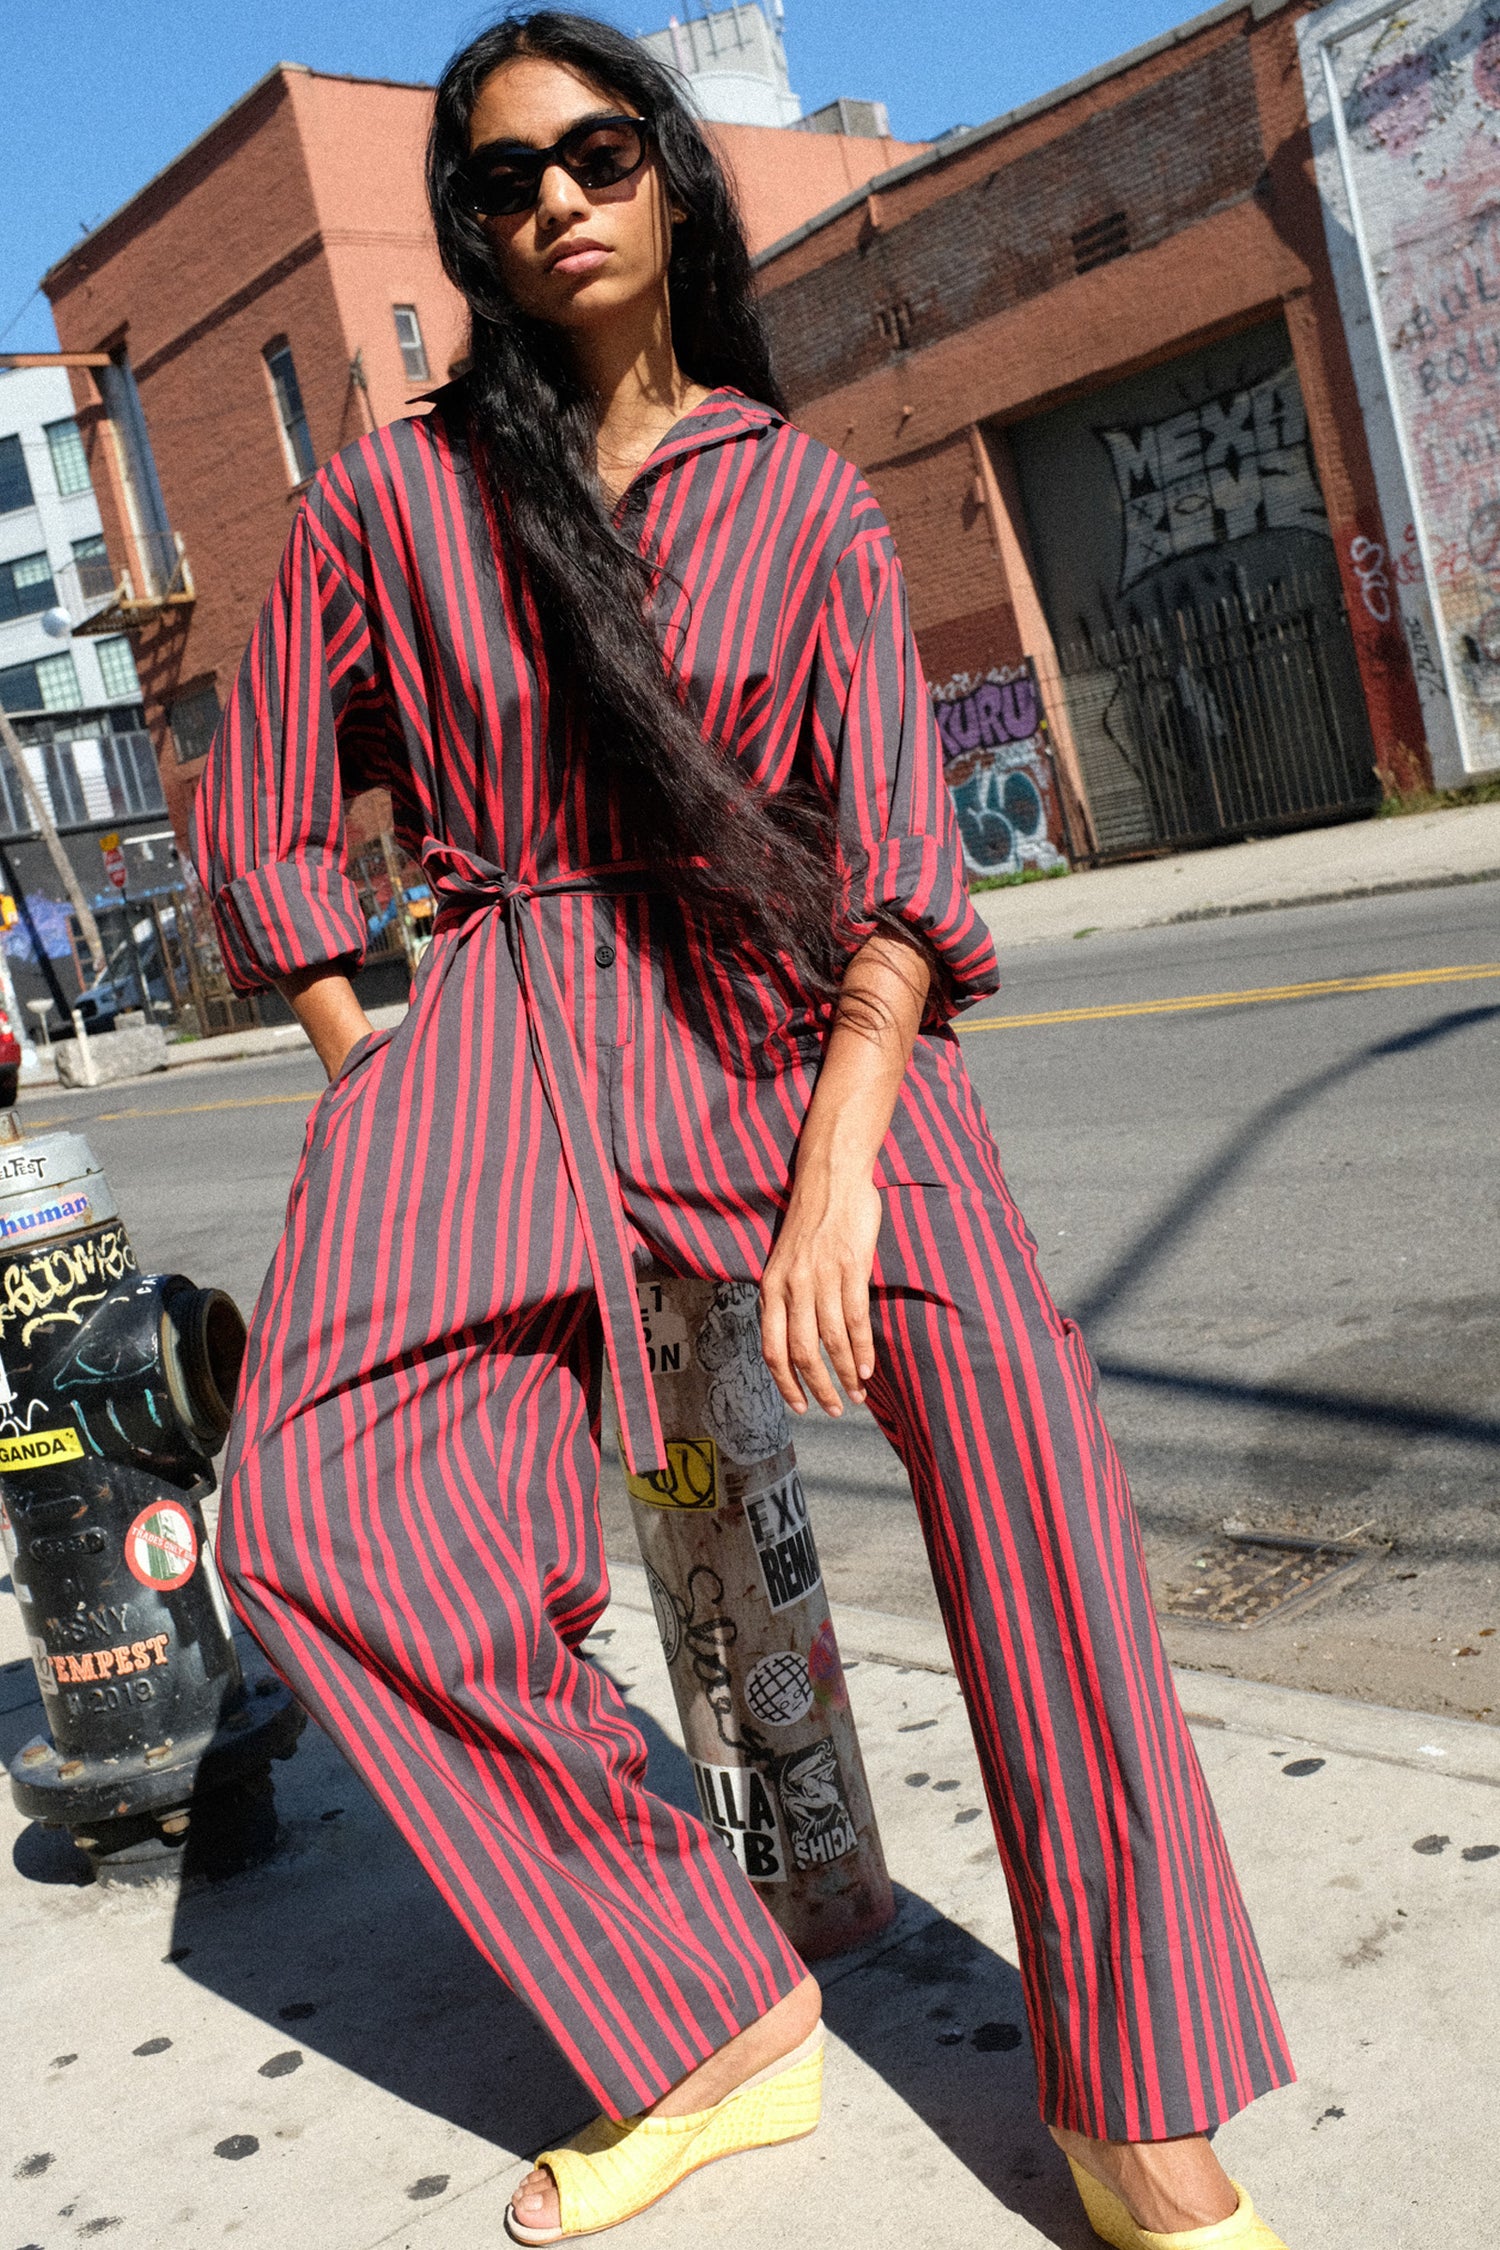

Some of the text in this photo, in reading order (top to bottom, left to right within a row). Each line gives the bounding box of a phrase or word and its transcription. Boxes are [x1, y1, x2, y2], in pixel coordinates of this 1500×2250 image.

[0, 1196, 88, 1237] human
[746, 1477, 807, 1545] EXO
[131, 1526, 164, 1547] TRADES
[163, 1541, 185, 1559] ONLY
[91, 1677, 155, 1714] 2019
